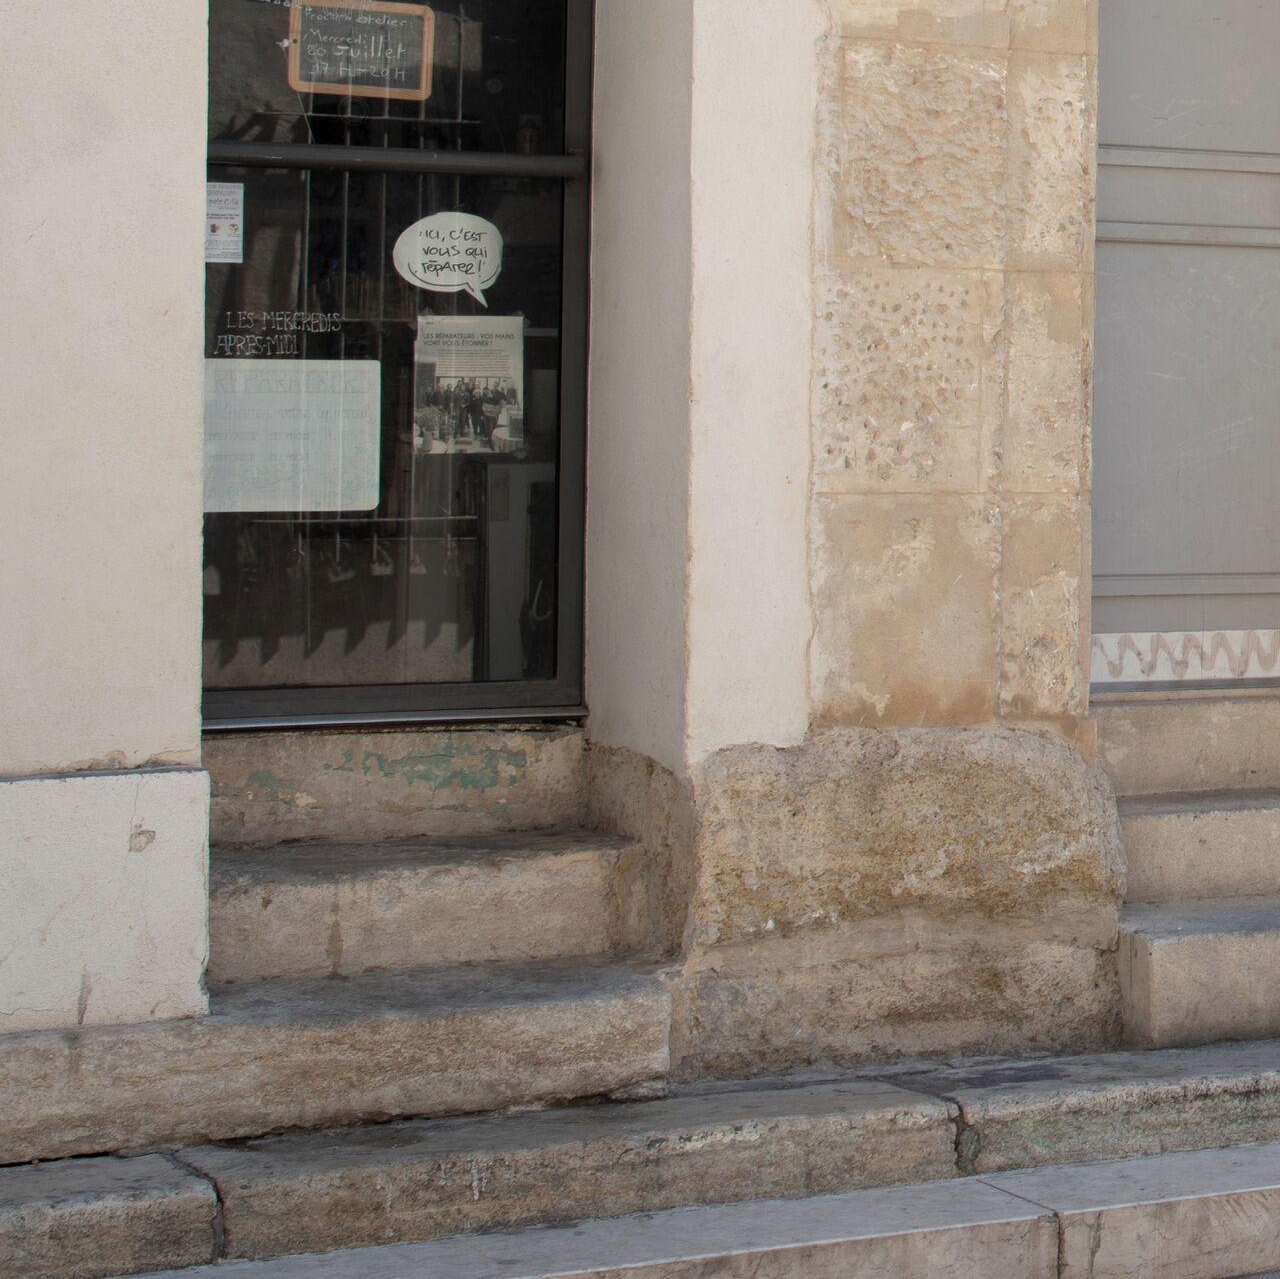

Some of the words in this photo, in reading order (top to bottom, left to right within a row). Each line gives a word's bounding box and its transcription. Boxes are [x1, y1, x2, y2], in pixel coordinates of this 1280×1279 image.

[303, 28, 368, 45] Mercredi
[334, 35, 407, 60] Juillet
[225, 311, 255, 329] LES
